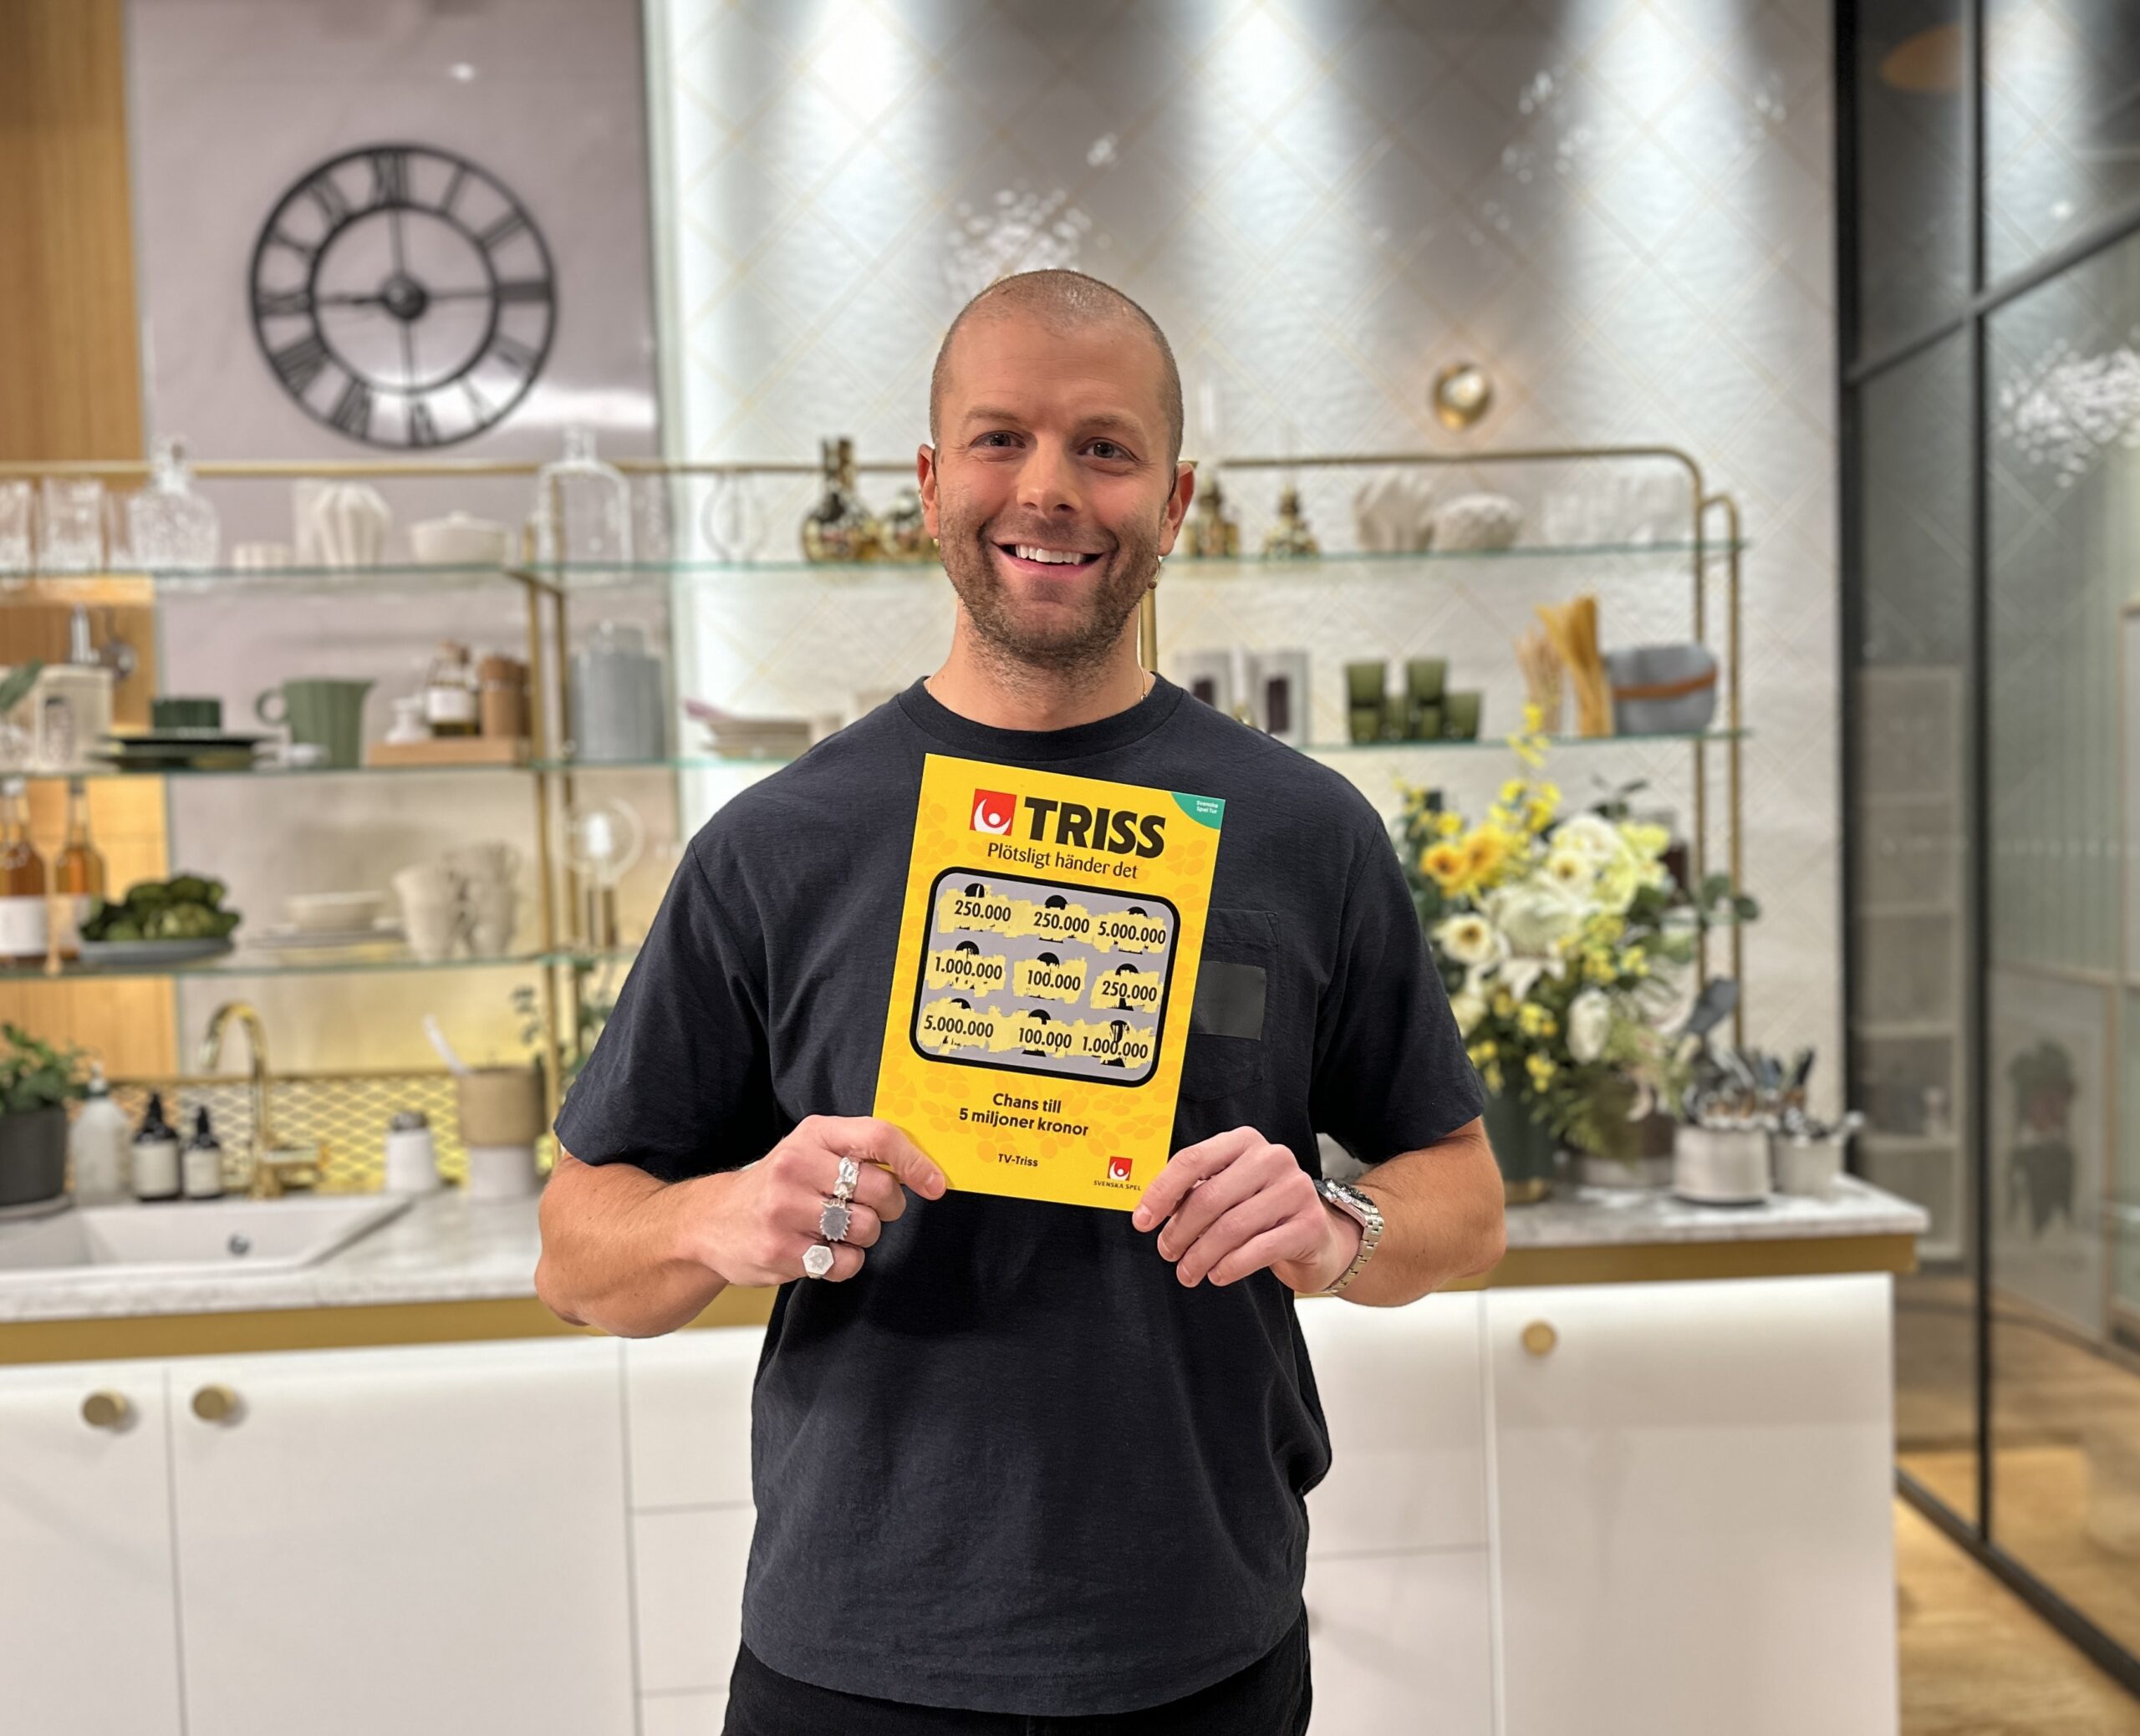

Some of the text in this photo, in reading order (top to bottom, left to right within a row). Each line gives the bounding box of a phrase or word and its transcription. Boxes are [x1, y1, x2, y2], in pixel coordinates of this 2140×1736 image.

[1024, 796, 1166, 859] TRISS
[987, 842, 1138, 878] Plötsligt händer det
[954, 899, 1011, 922] 250.000
[1033, 911, 1090, 934] 250.000
[1098, 921, 1166, 944] 5.000.000
[935, 956, 1003, 980] 1.000.000
[1027, 970, 1081, 991] 100.000
[1102, 980, 1158, 1002] 250.000
[924, 1014, 994, 1038] 5.000.000
[1018, 1027, 1073, 1049] 100.000
[1083, 1036, 1149, 1059] 1.000.000
[992, 1092, 1062, 1114] Chans till
[959, 1107, 1089, 1137] 5 miljoner kronor
[998, 1153, 1039, 1168] TV-Triss
[1093, 1179, 1142, 1192] SVENSKA SPEL
